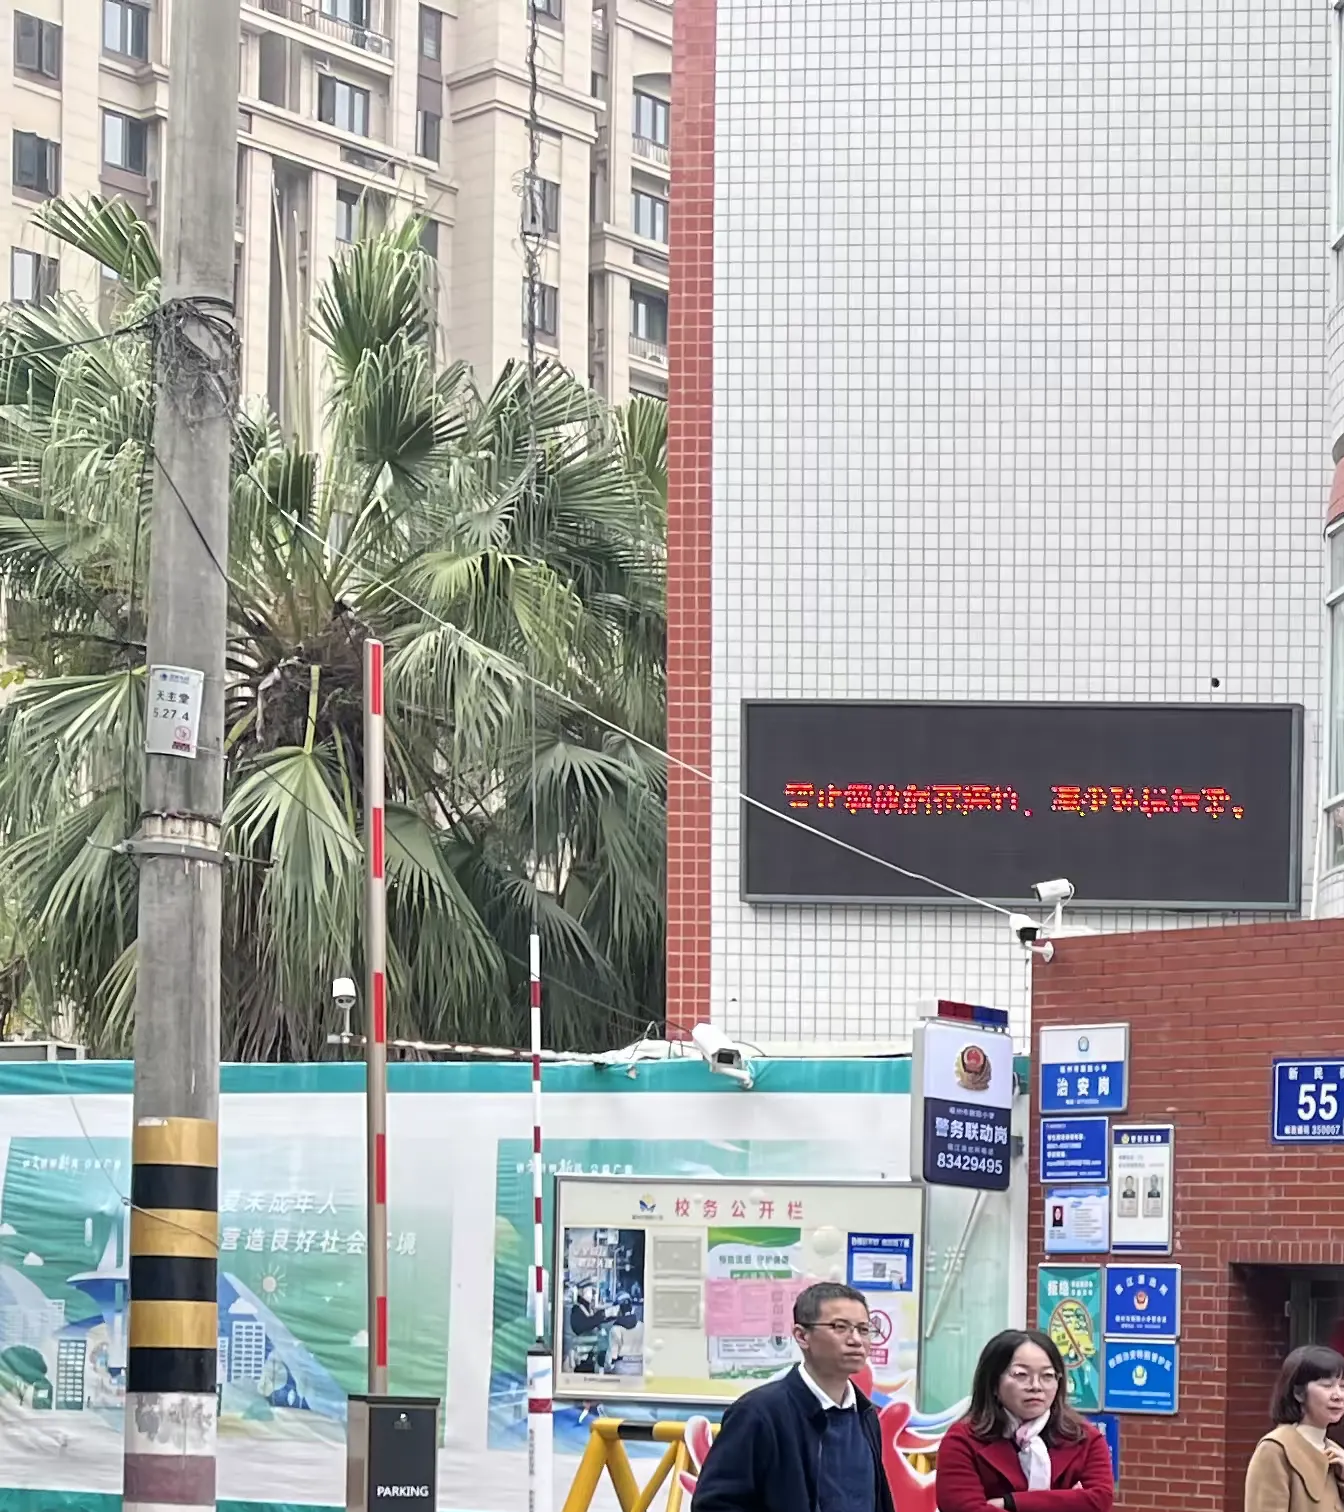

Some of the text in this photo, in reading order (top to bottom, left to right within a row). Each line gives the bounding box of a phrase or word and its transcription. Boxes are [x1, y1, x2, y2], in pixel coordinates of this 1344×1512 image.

[1056, 1076, 1110, 1097] 治安岗
[1297, 1083, 1338, 1121] 55
[935, 1117, 1008, 1145] 警务联动岗
[936, 1152, 1004, 1175] 83429495
[674, 1197, 804, 1221] 校务公开栏
[219, 1227, 417, 1256] 营造良好社会境
[376, 1485, 430, 1498] PARKING
